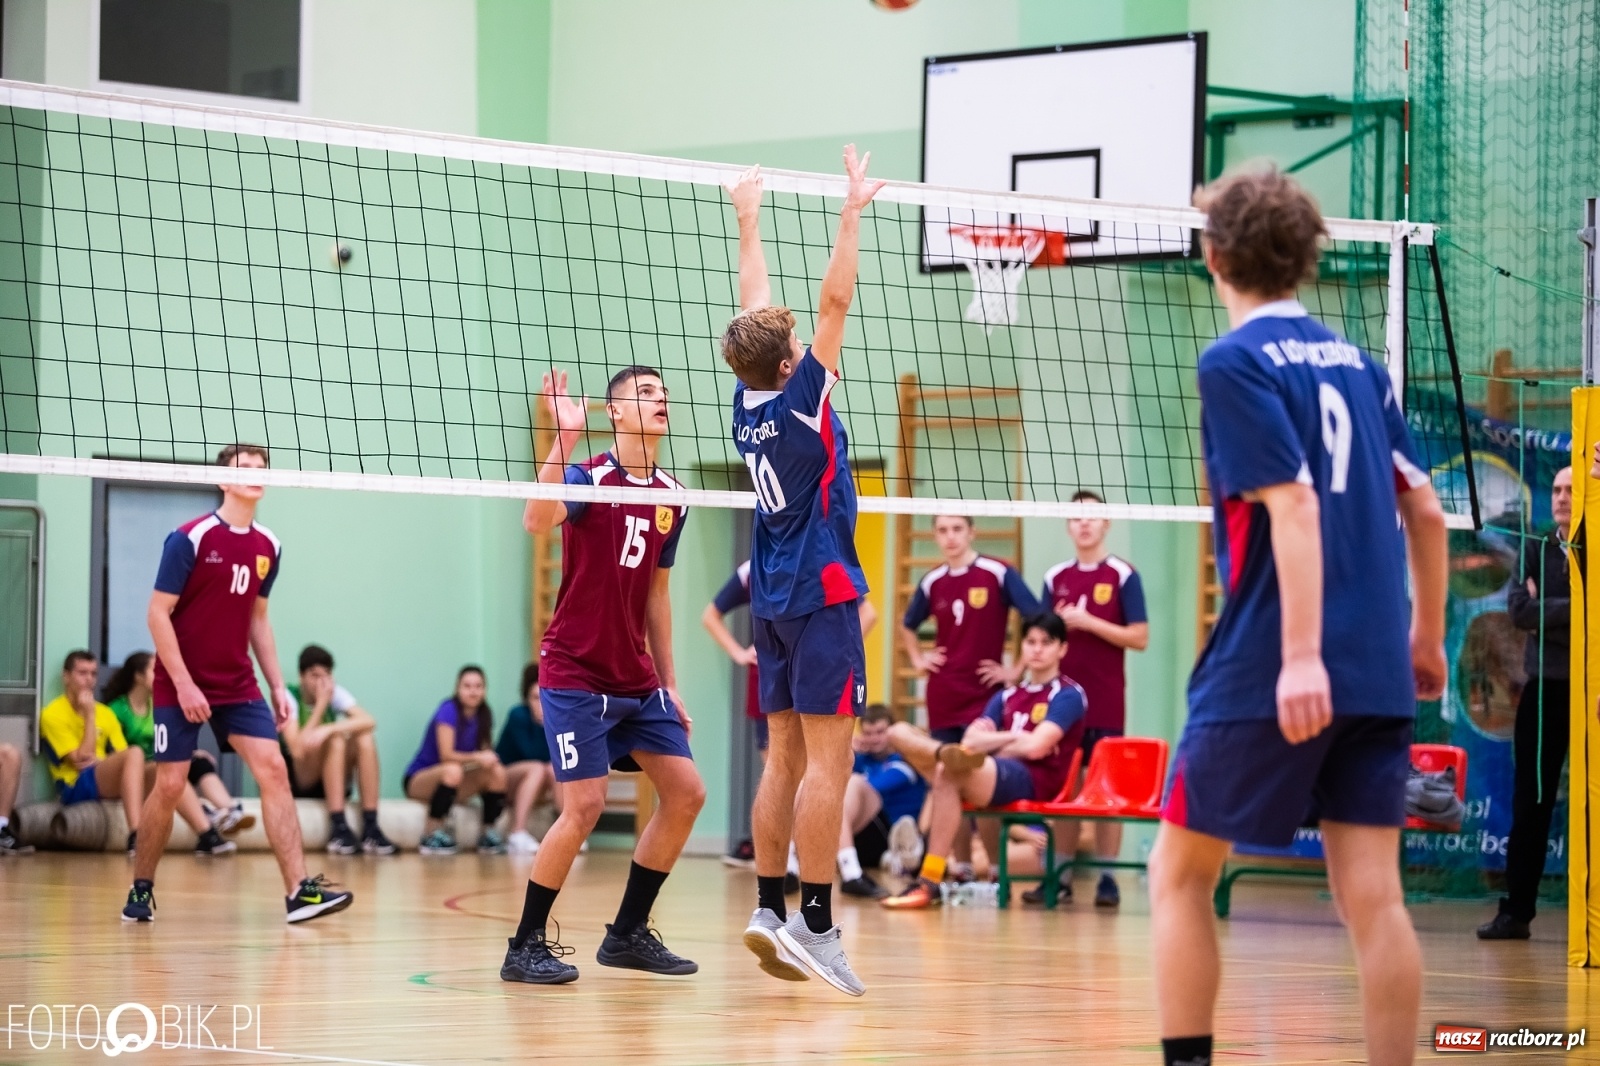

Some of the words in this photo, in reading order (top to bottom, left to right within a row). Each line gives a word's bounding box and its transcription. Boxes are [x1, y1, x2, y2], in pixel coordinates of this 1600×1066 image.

[1319, 382, 1352, 494] 9
[745, 452, 787, 513] 10
[619, 515, 650, 569] 15
[230, 564, 250, 595] 10
[952, 599, 965, 626] 9
[857, 685, 864, 703] 10
[154, 723, 168, 754] 10
[556, 731, 579, 770] 15
